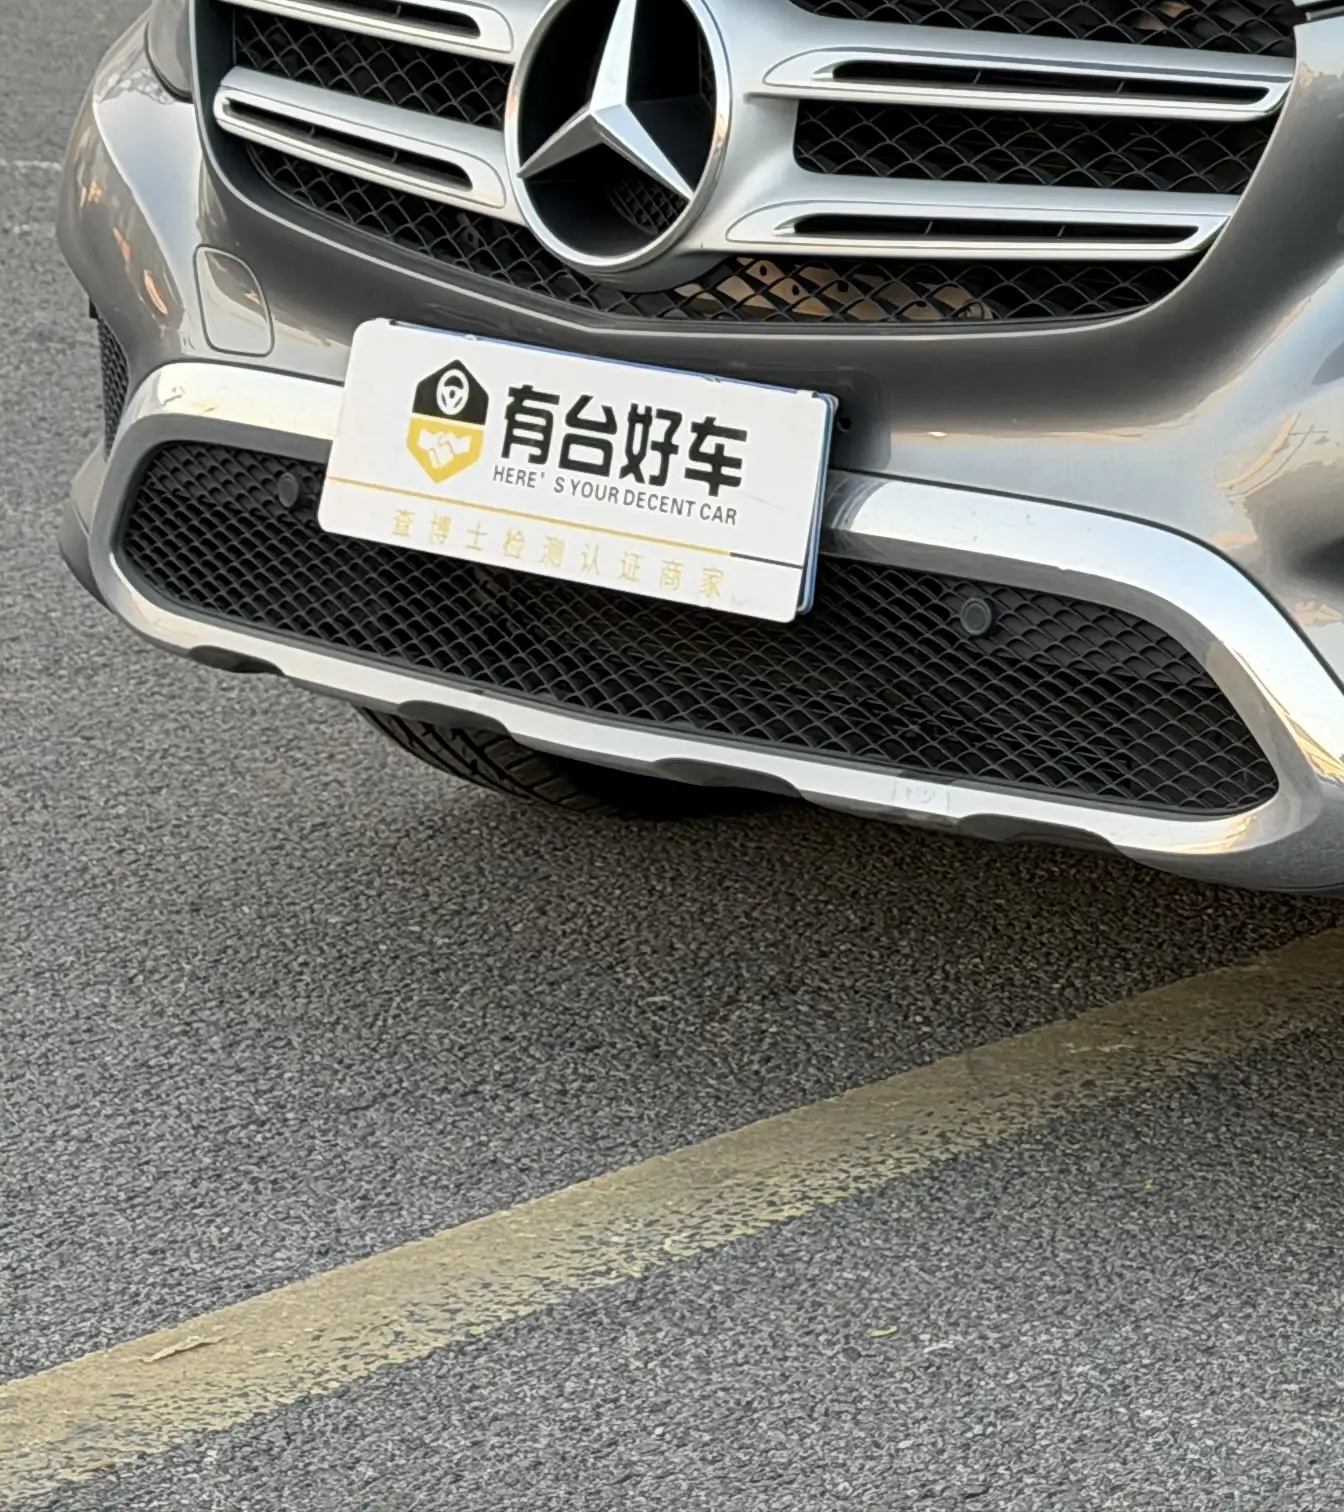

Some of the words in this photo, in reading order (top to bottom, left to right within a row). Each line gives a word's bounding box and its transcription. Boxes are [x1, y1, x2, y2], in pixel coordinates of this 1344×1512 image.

[501, 384, 748, 498] 有台好车
[570, 478, 620, 506] YOUR
[622, 489, 697, 518] DECENT
[699, 502, 738, 527] CAR
[390, 507, 727, 602] 查博士检测认证商家
